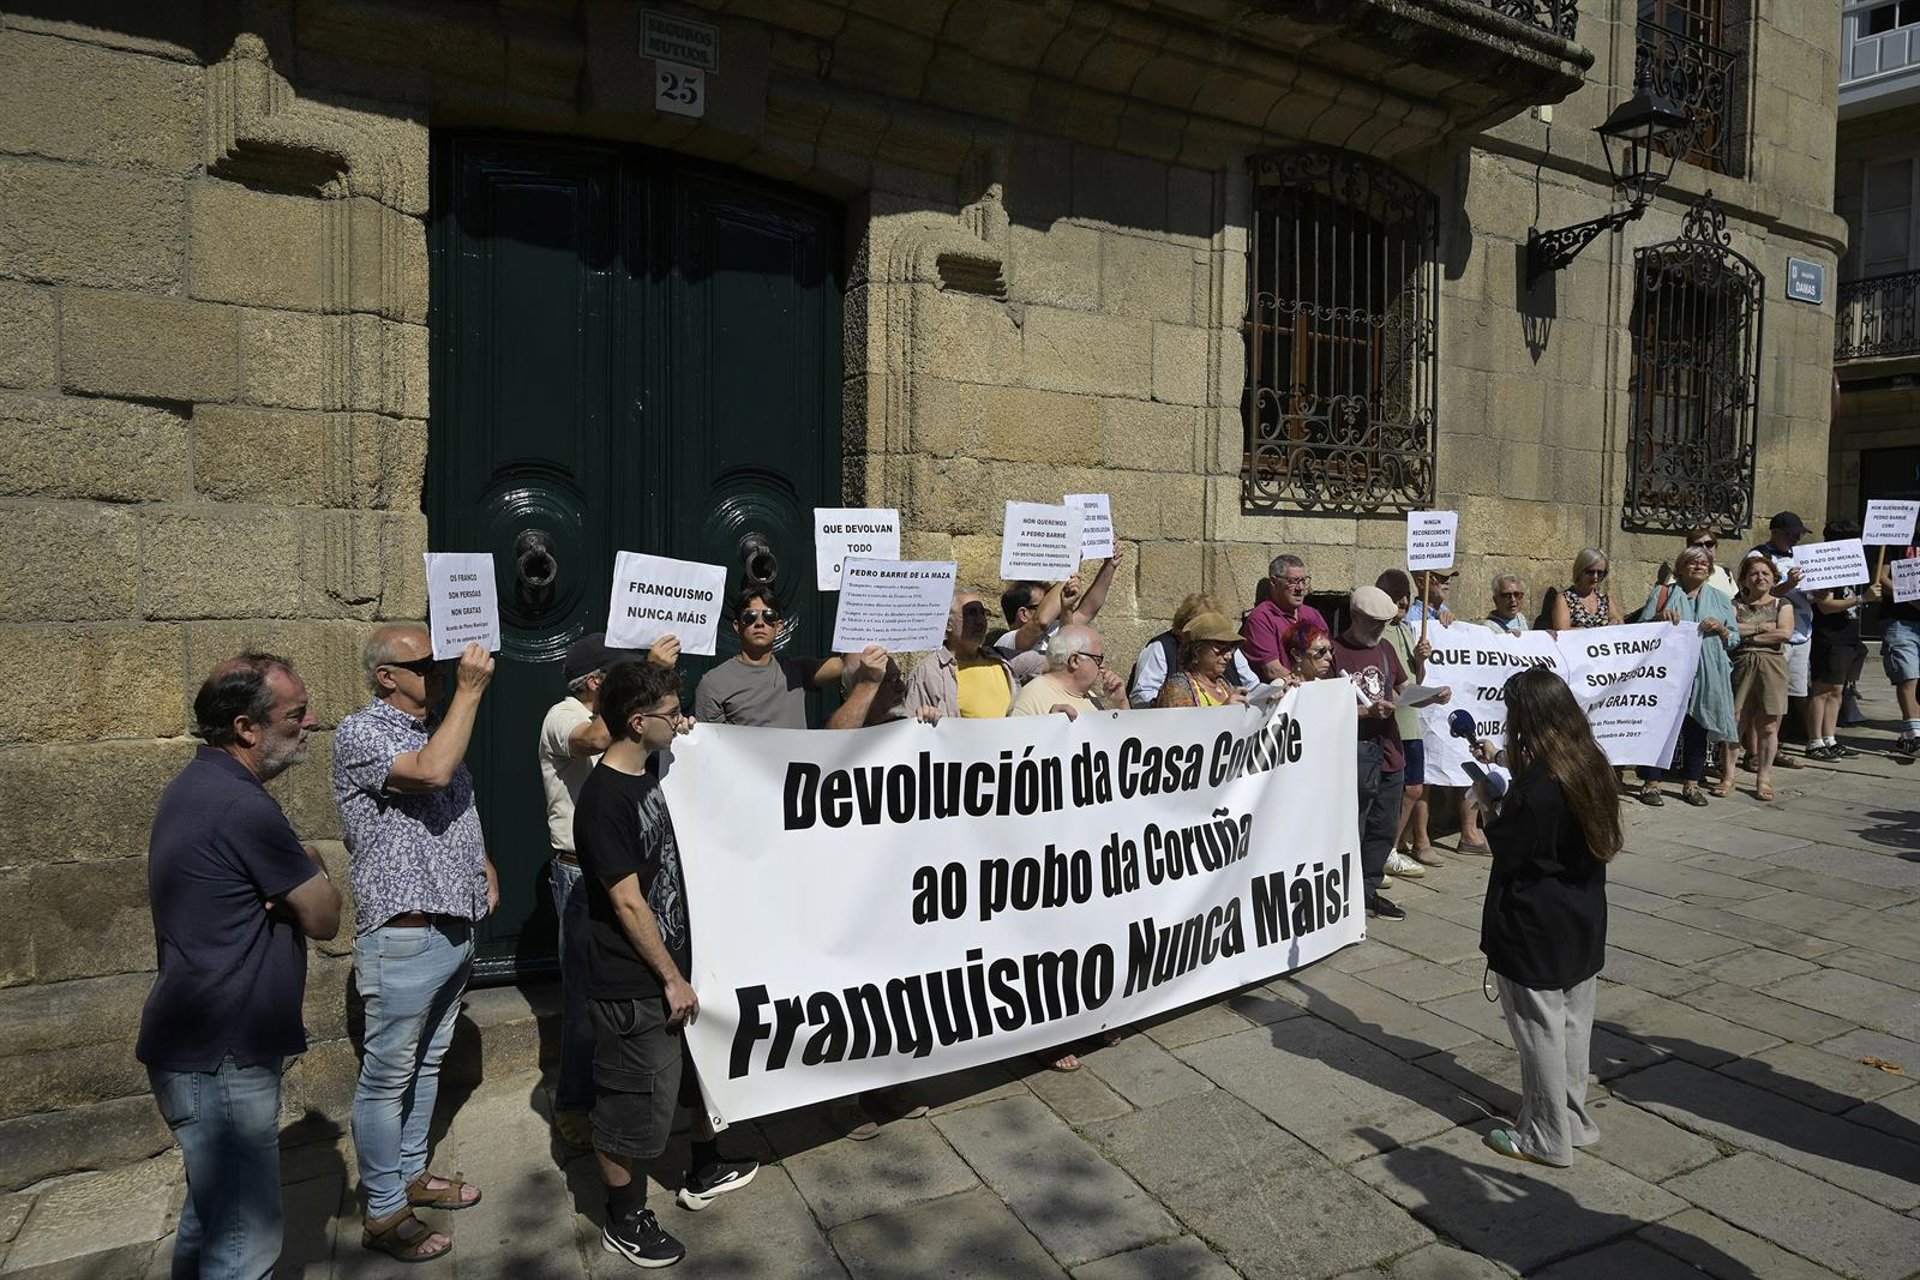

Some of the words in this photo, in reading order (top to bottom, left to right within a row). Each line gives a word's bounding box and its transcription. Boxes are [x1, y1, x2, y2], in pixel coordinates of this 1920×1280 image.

[648, 17, 712, 47] SEGUROS
[660, 72, 697, 104] 25
[1796, 281, 1816, 296] DAMAS
[823, 524, 843, 534] QUE
[846, 524, 892, 534] DEVOLVAN
[847, 544, 872, 552] TODO
[834, 564, 840, 573] O
[850, 569, 878, 577] PEDRO
[449, 591, 459, 600] SON
[629, 582, 713, 602] FRANQUISMO
[463, 606, 481, 615] GRATAS
[627, 606, 673, 621] NUNCA
[676, 610, 707, 625] MÁIS
[1586, 644, 1611, 658] OS
[1614, 638, 1661, 654] FRANCO
[1428, 649, 1471, 666] QUE
[1586, 672, 1616, 687] SON
[1476, 687, 1505, 701] TOD
[1606, 694, 1658, 708] GRATAS
[783, 745, 1063, 830] Devolución
[1071, 742, 1113, 808] da
[1118, 736, 1204, 800] Casa
[912, 861, 967, 925] ao
[980, 844, 1093, 922] pobo
[1101, 832, 1140, 898] da
[1143, 805, 1253, 886] Coruña
[728, 942, 1114, 1079] Franquismo
[1123, 896, 1246, 999] Nunca
[1251, 851, 1351, 948] Máis!
